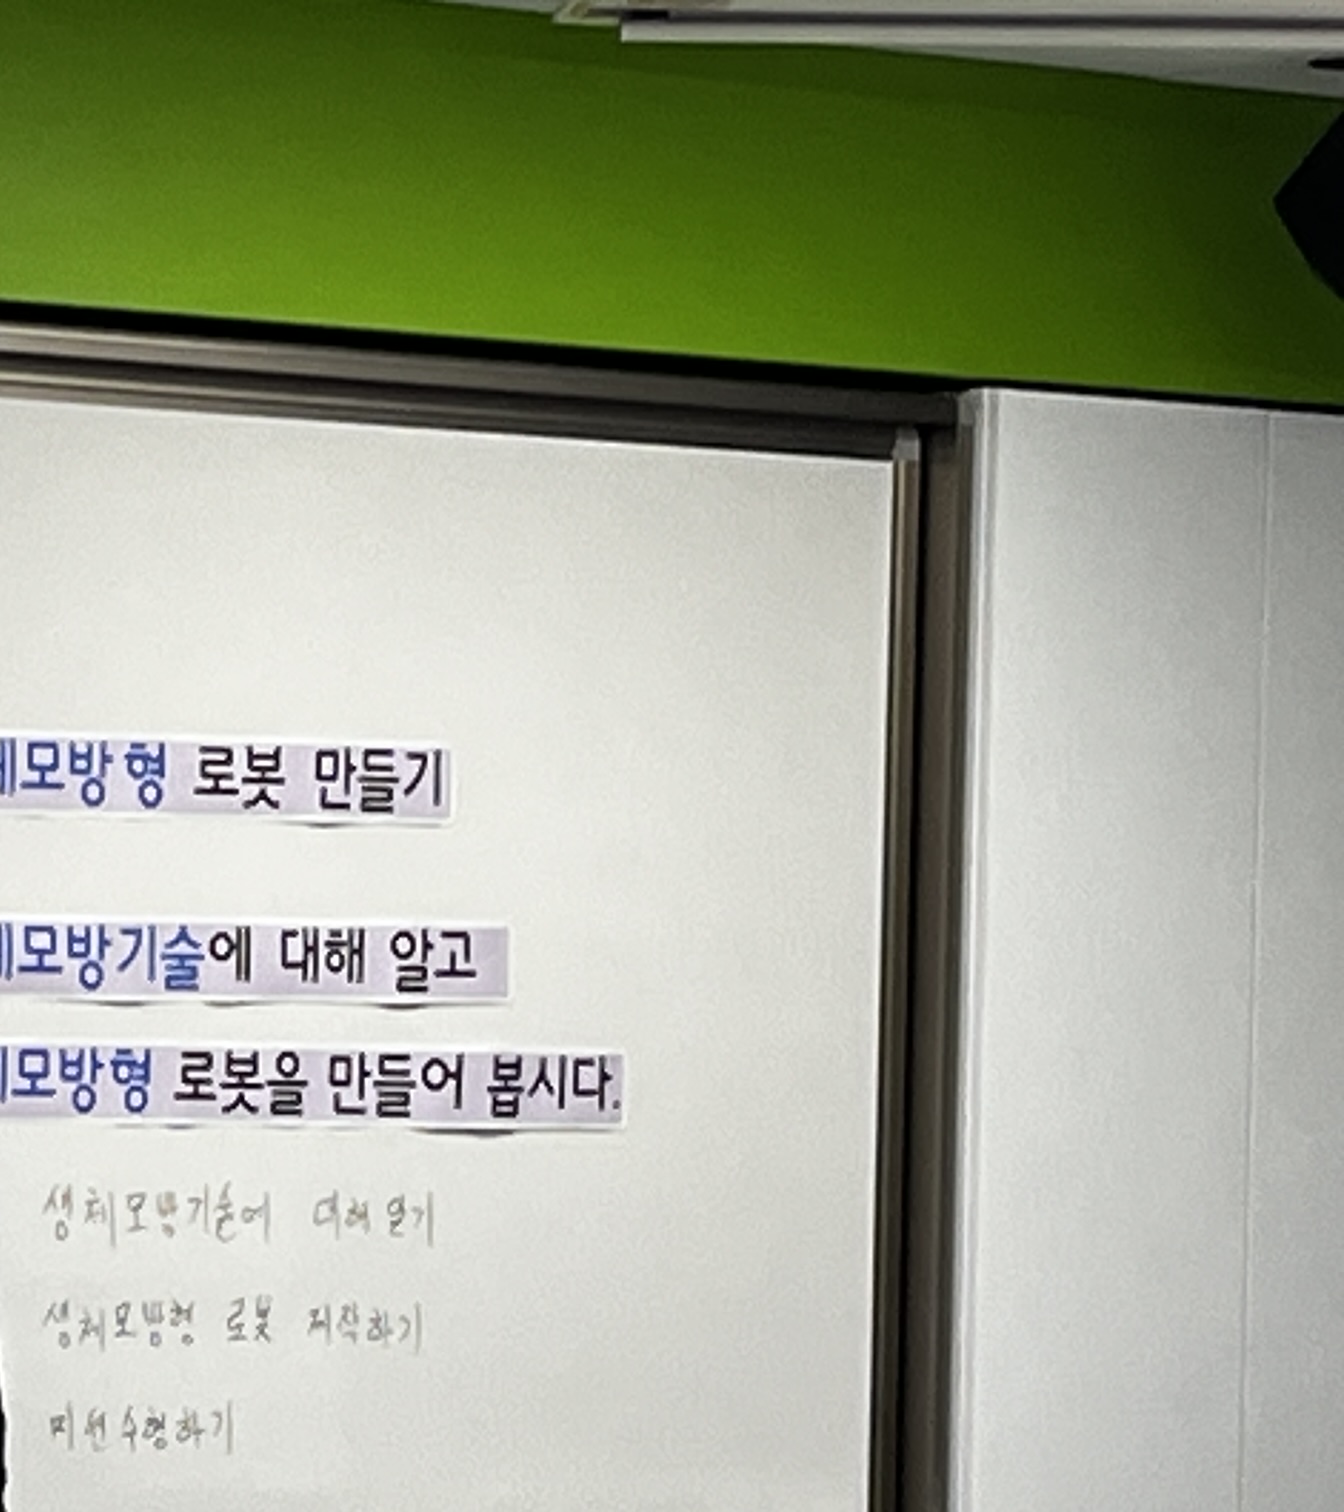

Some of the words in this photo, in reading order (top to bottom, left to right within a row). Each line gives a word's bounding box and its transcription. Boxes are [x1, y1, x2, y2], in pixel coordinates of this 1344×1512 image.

[193, 745, 286, 810] 로봇
[315, 746, 442, 815] 만들기
[280, 926, 366, 984] 대해
[390, 928, 477, 994] 알고
[173, 1049, 309, 1117] 로봇을
[328, 1051, 465, 1119] 만들어
[486, 1054, 620, 1119] 봅시다.
[225, 1293, 274, 1345] 로봇
